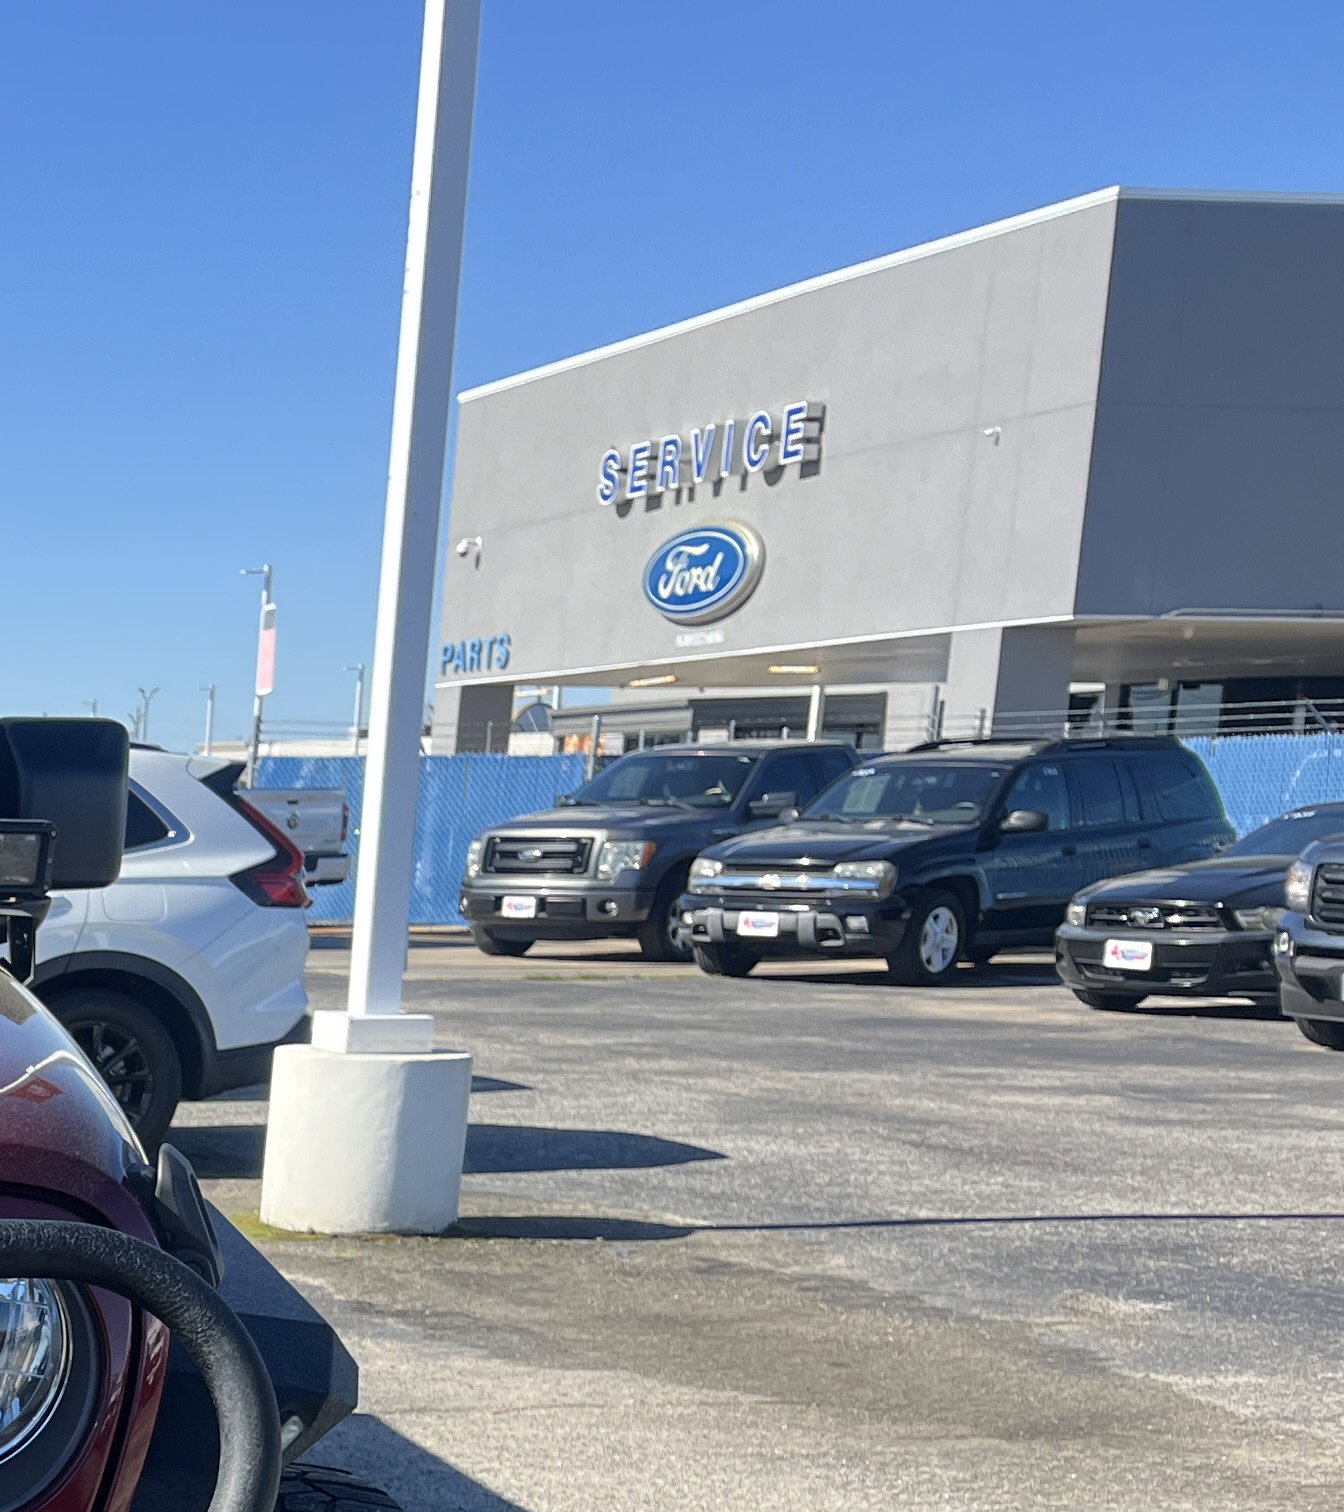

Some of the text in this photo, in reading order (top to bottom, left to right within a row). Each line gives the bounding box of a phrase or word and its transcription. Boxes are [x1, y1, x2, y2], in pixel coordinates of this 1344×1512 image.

[596, 400, 809, 506] SERVICE
[658, 542, 725, 600] Ford
[440, 631, 512, 677] PARTS
